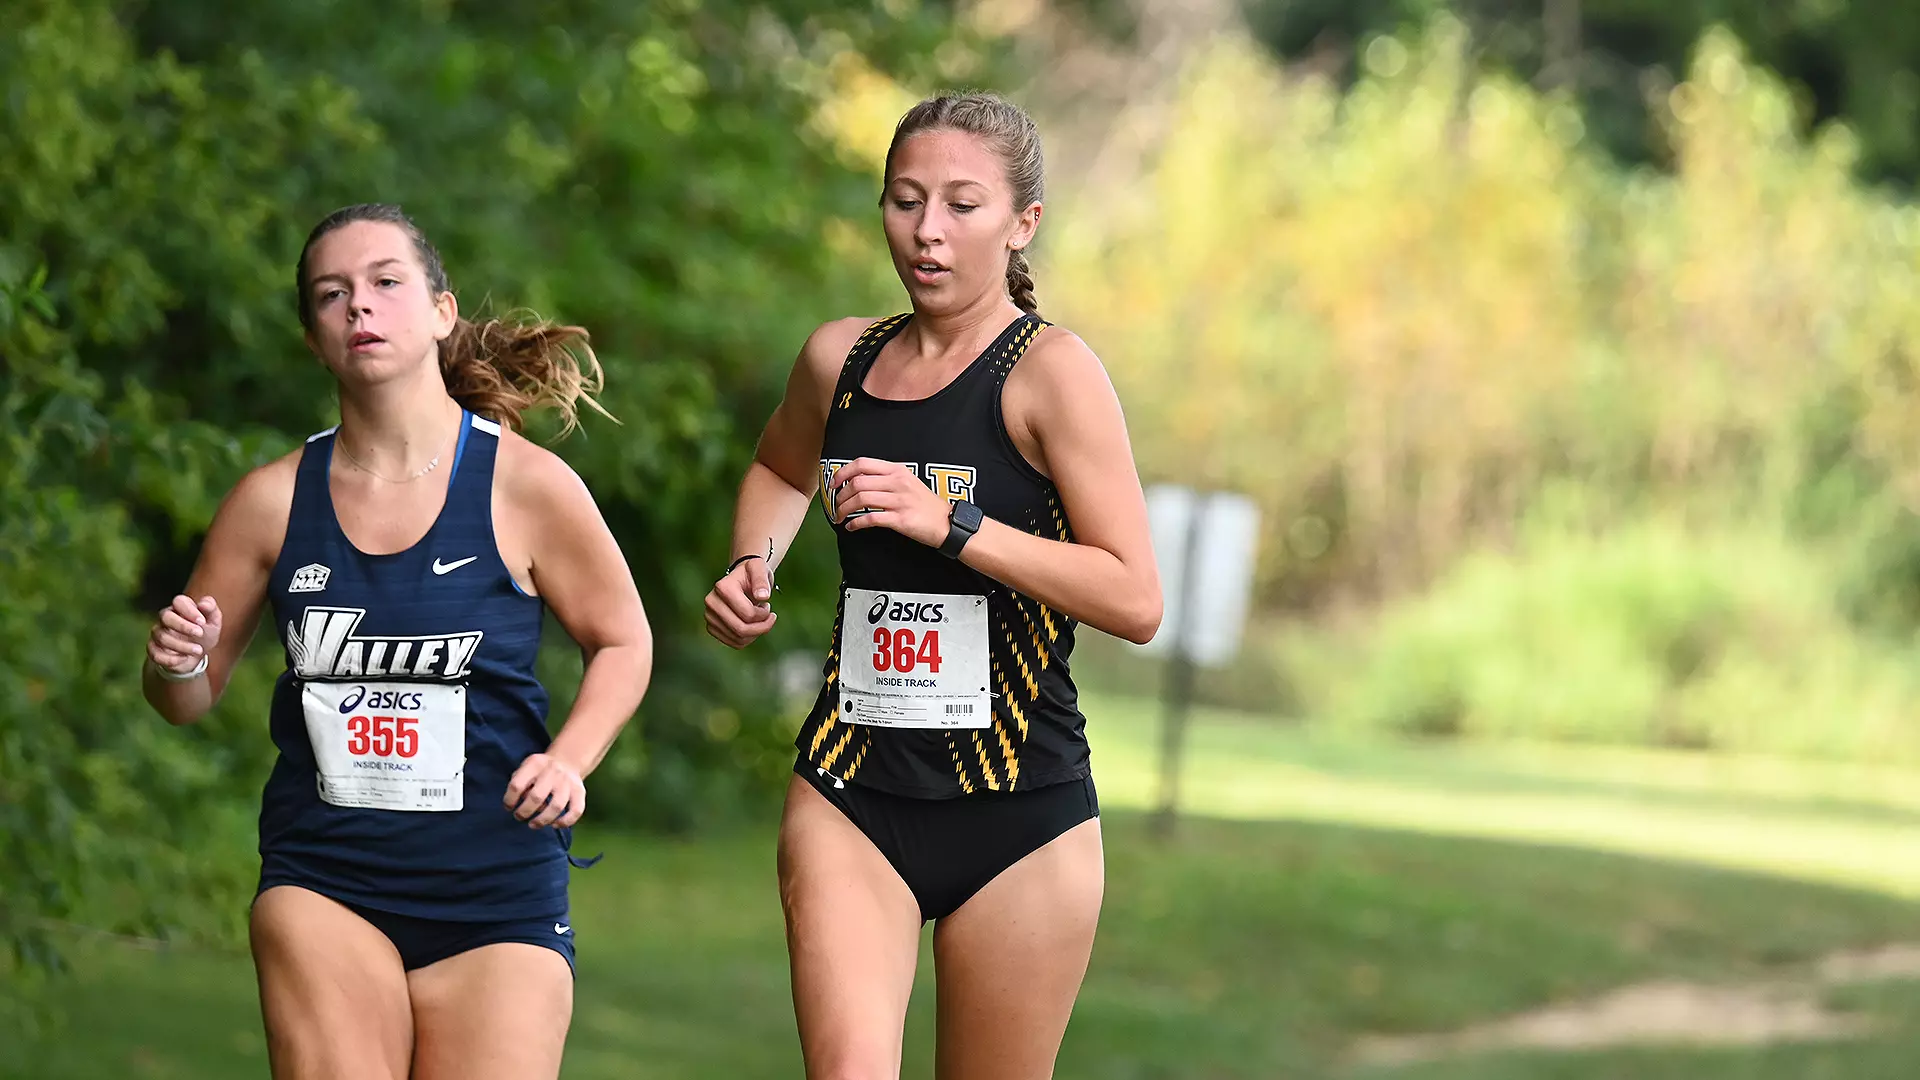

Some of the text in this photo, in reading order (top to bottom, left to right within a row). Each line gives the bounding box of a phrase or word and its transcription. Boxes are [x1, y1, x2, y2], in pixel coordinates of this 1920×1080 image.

[293, 578, 324, 589] MAC
[872, 627, 942, 673] 364
[875, 677, 937, 688] INSIDE TRACK
[347, 715, 419, 758] 355
[353, 761, 413, 771] INSIDE TRACK
